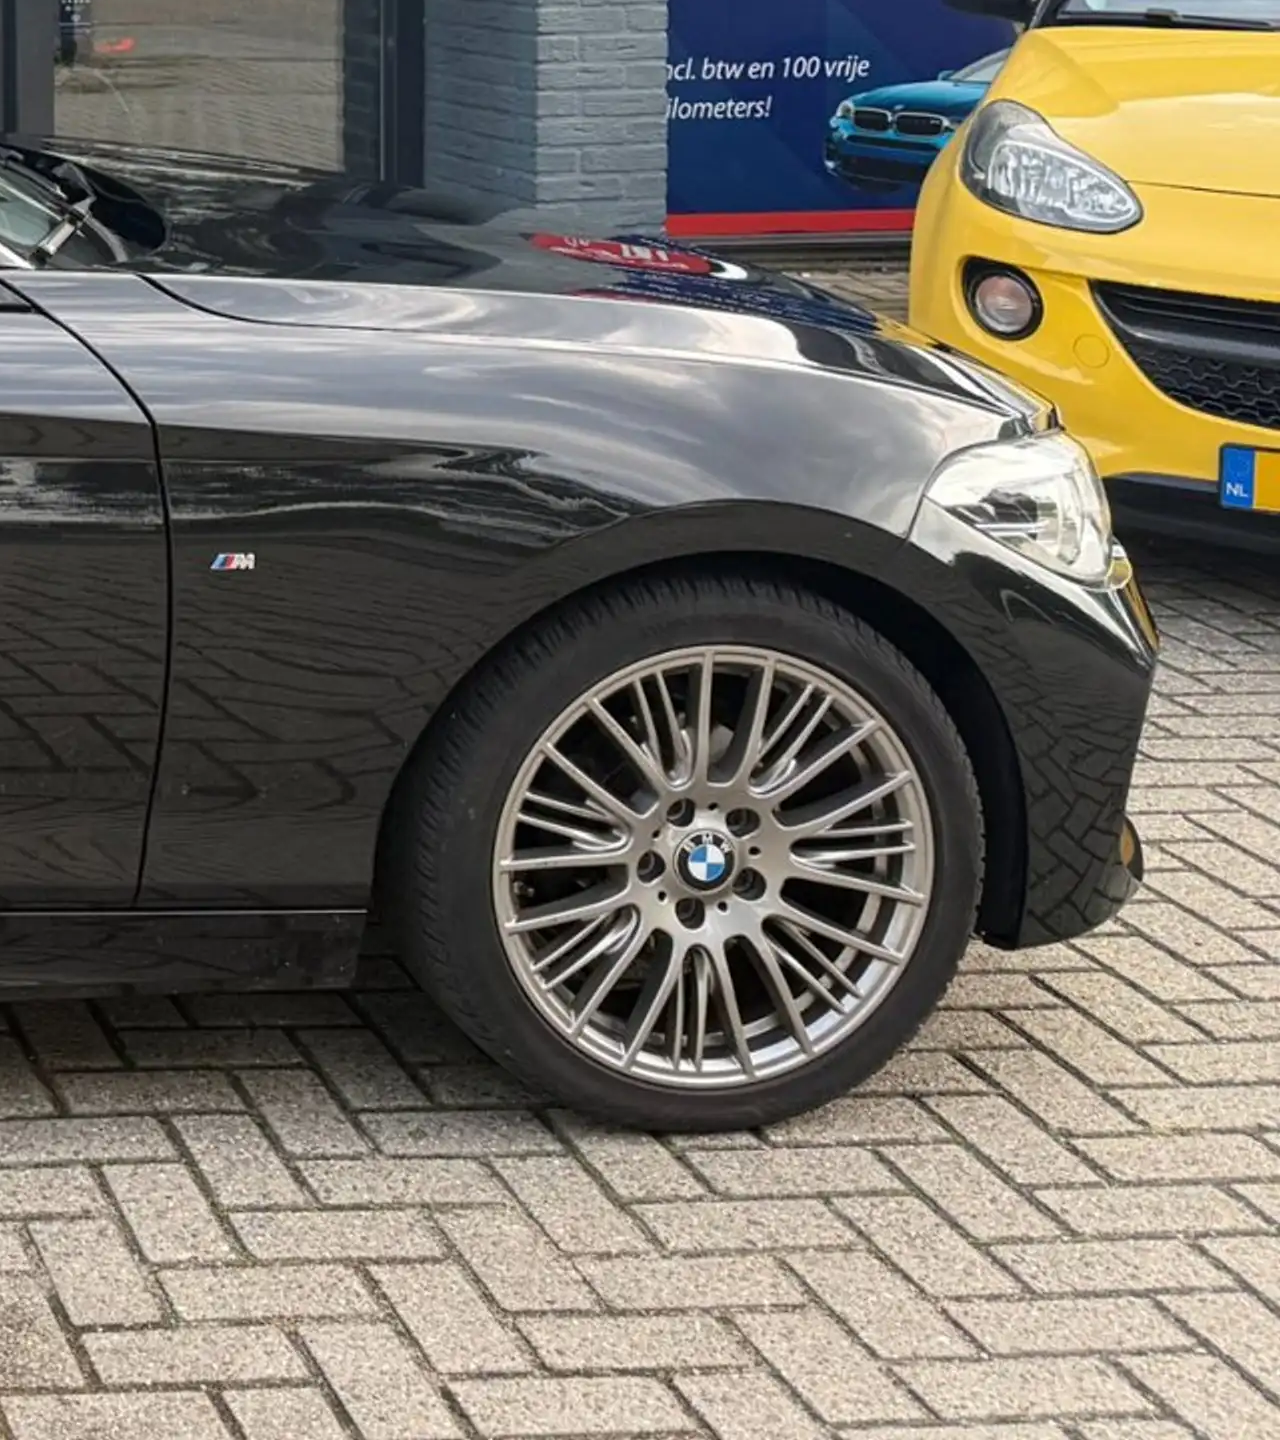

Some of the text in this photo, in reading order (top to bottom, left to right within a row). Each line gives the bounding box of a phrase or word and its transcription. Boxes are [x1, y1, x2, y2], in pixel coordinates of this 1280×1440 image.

[666, 55, 871, 82] ncl. btw en 100 vrije
[666, 95, 772, 120] ilometers!
[1226, 482, 1249, 498] NL
